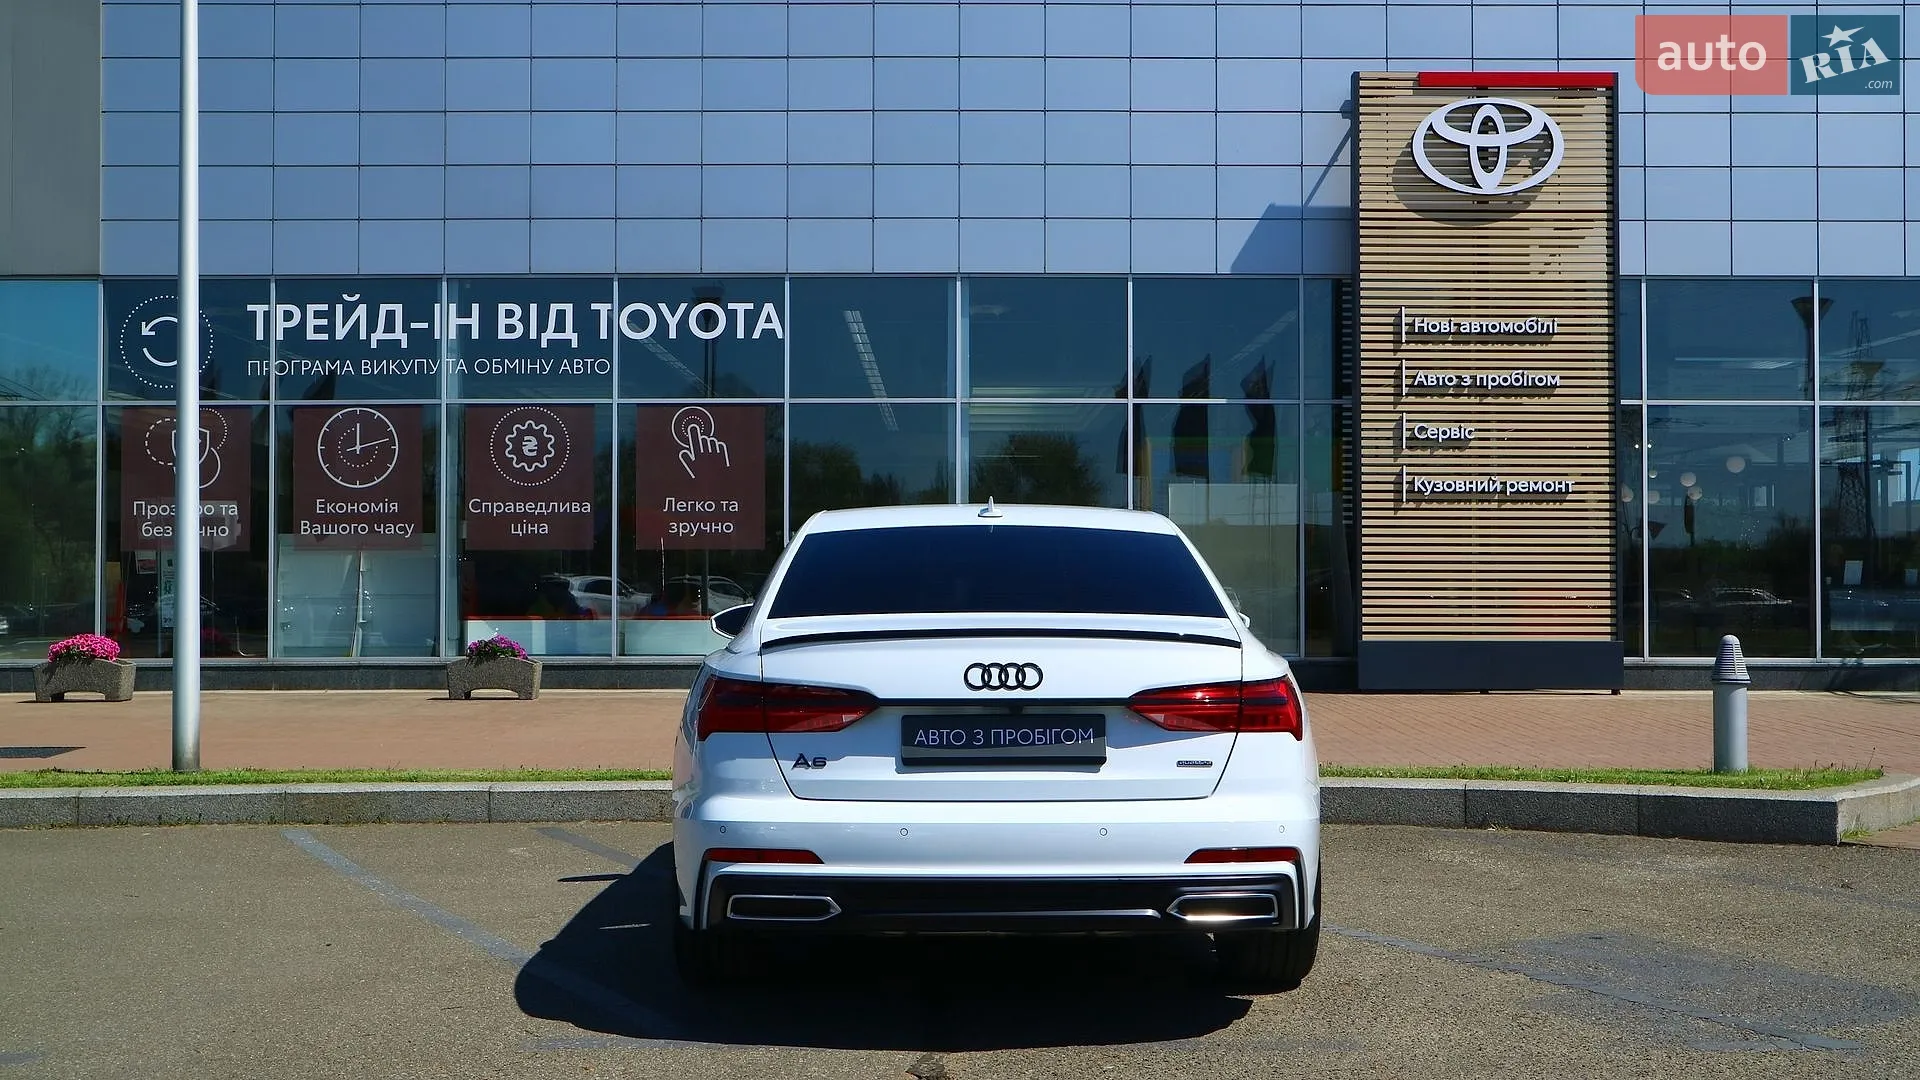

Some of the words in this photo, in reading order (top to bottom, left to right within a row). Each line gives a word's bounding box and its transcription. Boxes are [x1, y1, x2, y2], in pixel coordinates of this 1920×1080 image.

[247, 293, 480, 349] ТРЕЙД-ІН
[497, 303, 578, 348] ВІД
[590, 302, 784, 340] TOYOTA
[1413, 318, 1455, 334] Нові
[1459, 317, 1559, 334] автомобілі
[247, 360, 355, 376] ПРОГРАМА
[361, 359, 440, 375] ВИКУПУ
[446, 358, 468, 374] ТА
[474, 358, 554, 375] ОБМІНУ
[559, 358, 611, 375] АВТО
[1413, 371, 1457, 387] Авто
[1460, 374, 1471, 386] з
[1476, 370, 1560, 389] пробігом
[1413, 424, 1475, 442] Сервіс
[1413, 475, 1501, 496] Кузовний
[1506, 480, 1575, 496] ремонт
[133, 501, 214, 519] Прозо
[220, 504, 238, 515] та
[316, 498, 398, 514] Економія
[468, 498, 591, 516] Справедлива
[663, 497, 716, 512] Легко
[720, 500, 739, 512] та
[141, 521, 229, 537] безчно
[300, 520, 369, 535] Вашого
[374, 523, 415, 538] часу
[511, 519, 549, 536] ціна
[668, 521, 734, 537] зручно
[914, 729, 966, 745] АВТО
[991, 728, 1094, 745] ПРОБІГОМ
[792, 753, 828, 769] A6
